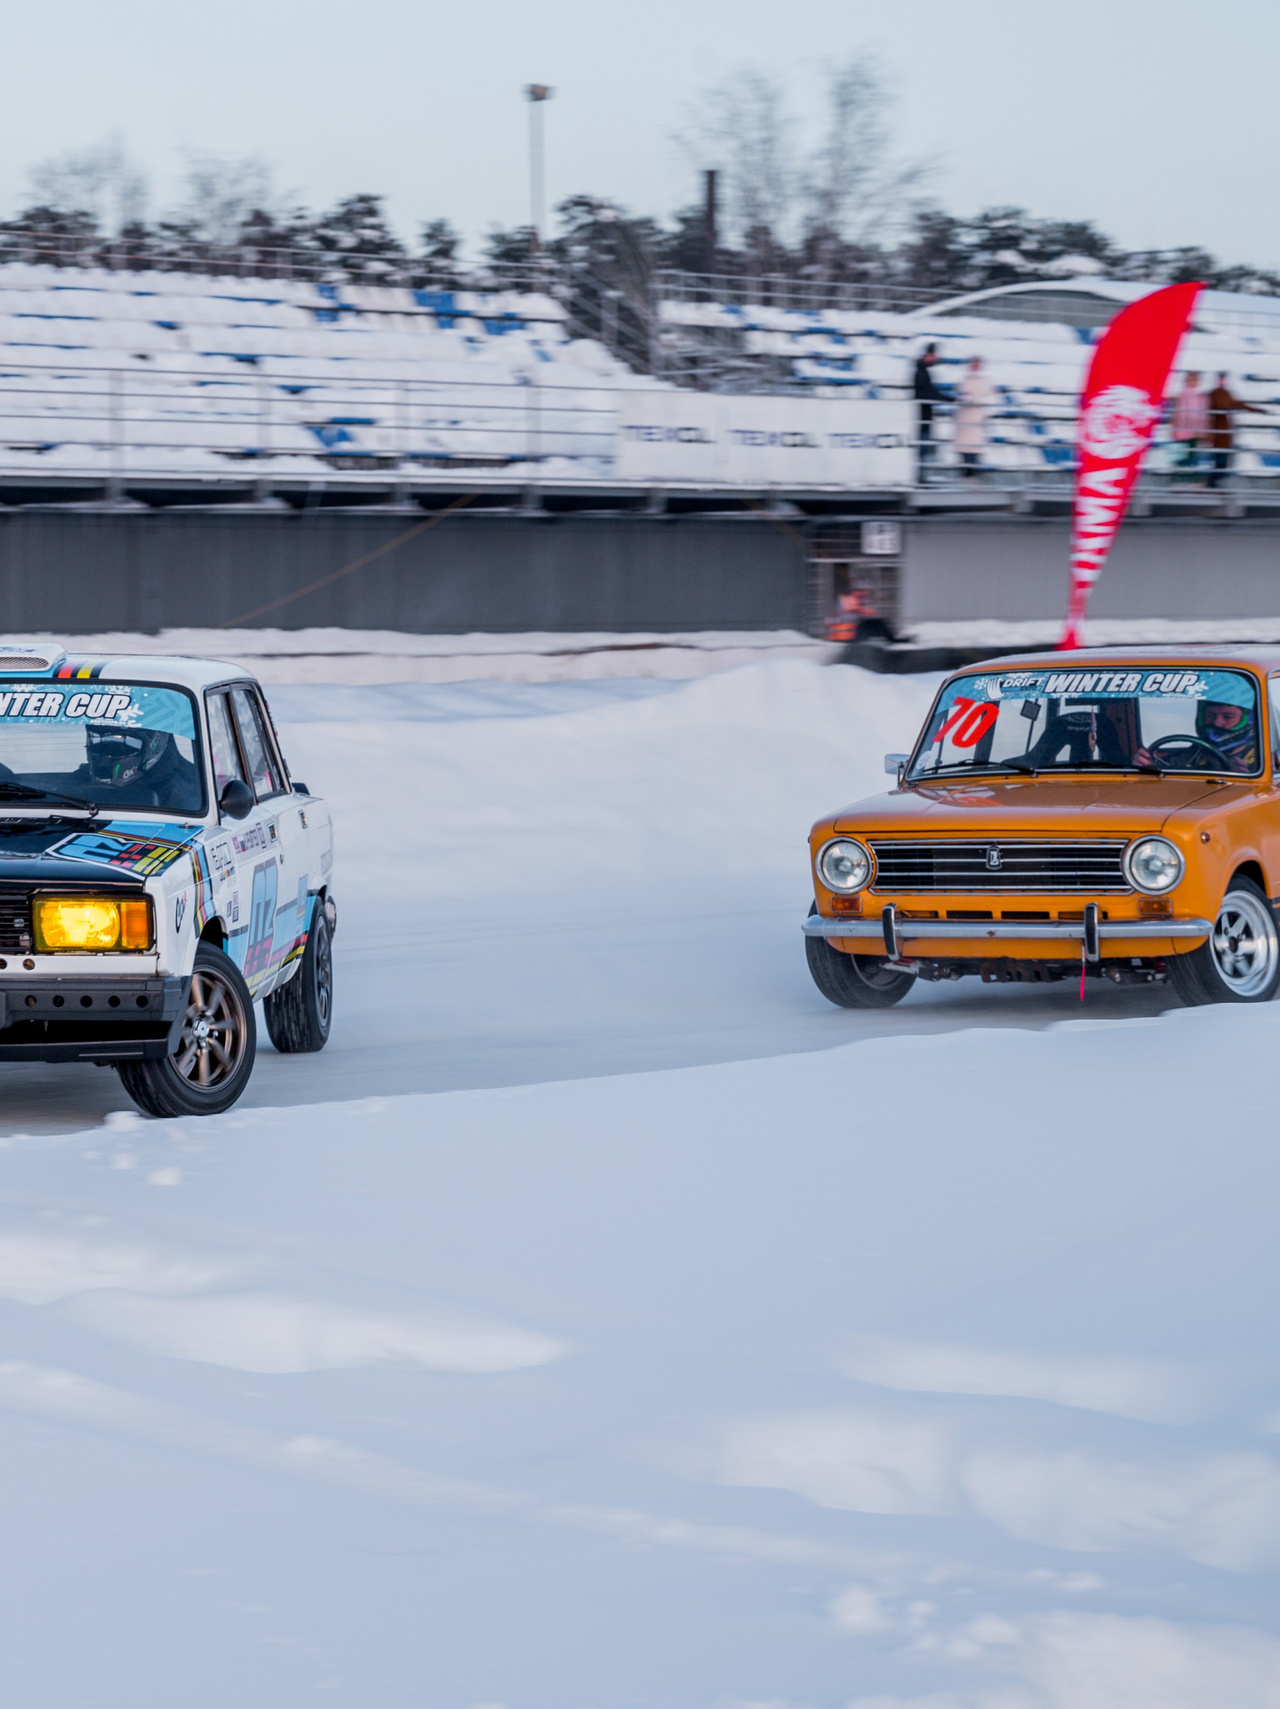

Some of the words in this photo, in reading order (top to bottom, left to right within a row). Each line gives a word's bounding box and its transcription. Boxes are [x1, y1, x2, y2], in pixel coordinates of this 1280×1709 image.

[1001, 677, 1046, 688] DRIFT
[1043, 673, 1142, 693] WINTER
[1142, 673, 1199, 693] CUP
[66, 693, 132, 719] CUP
[932, 696, 999, 748] 70
